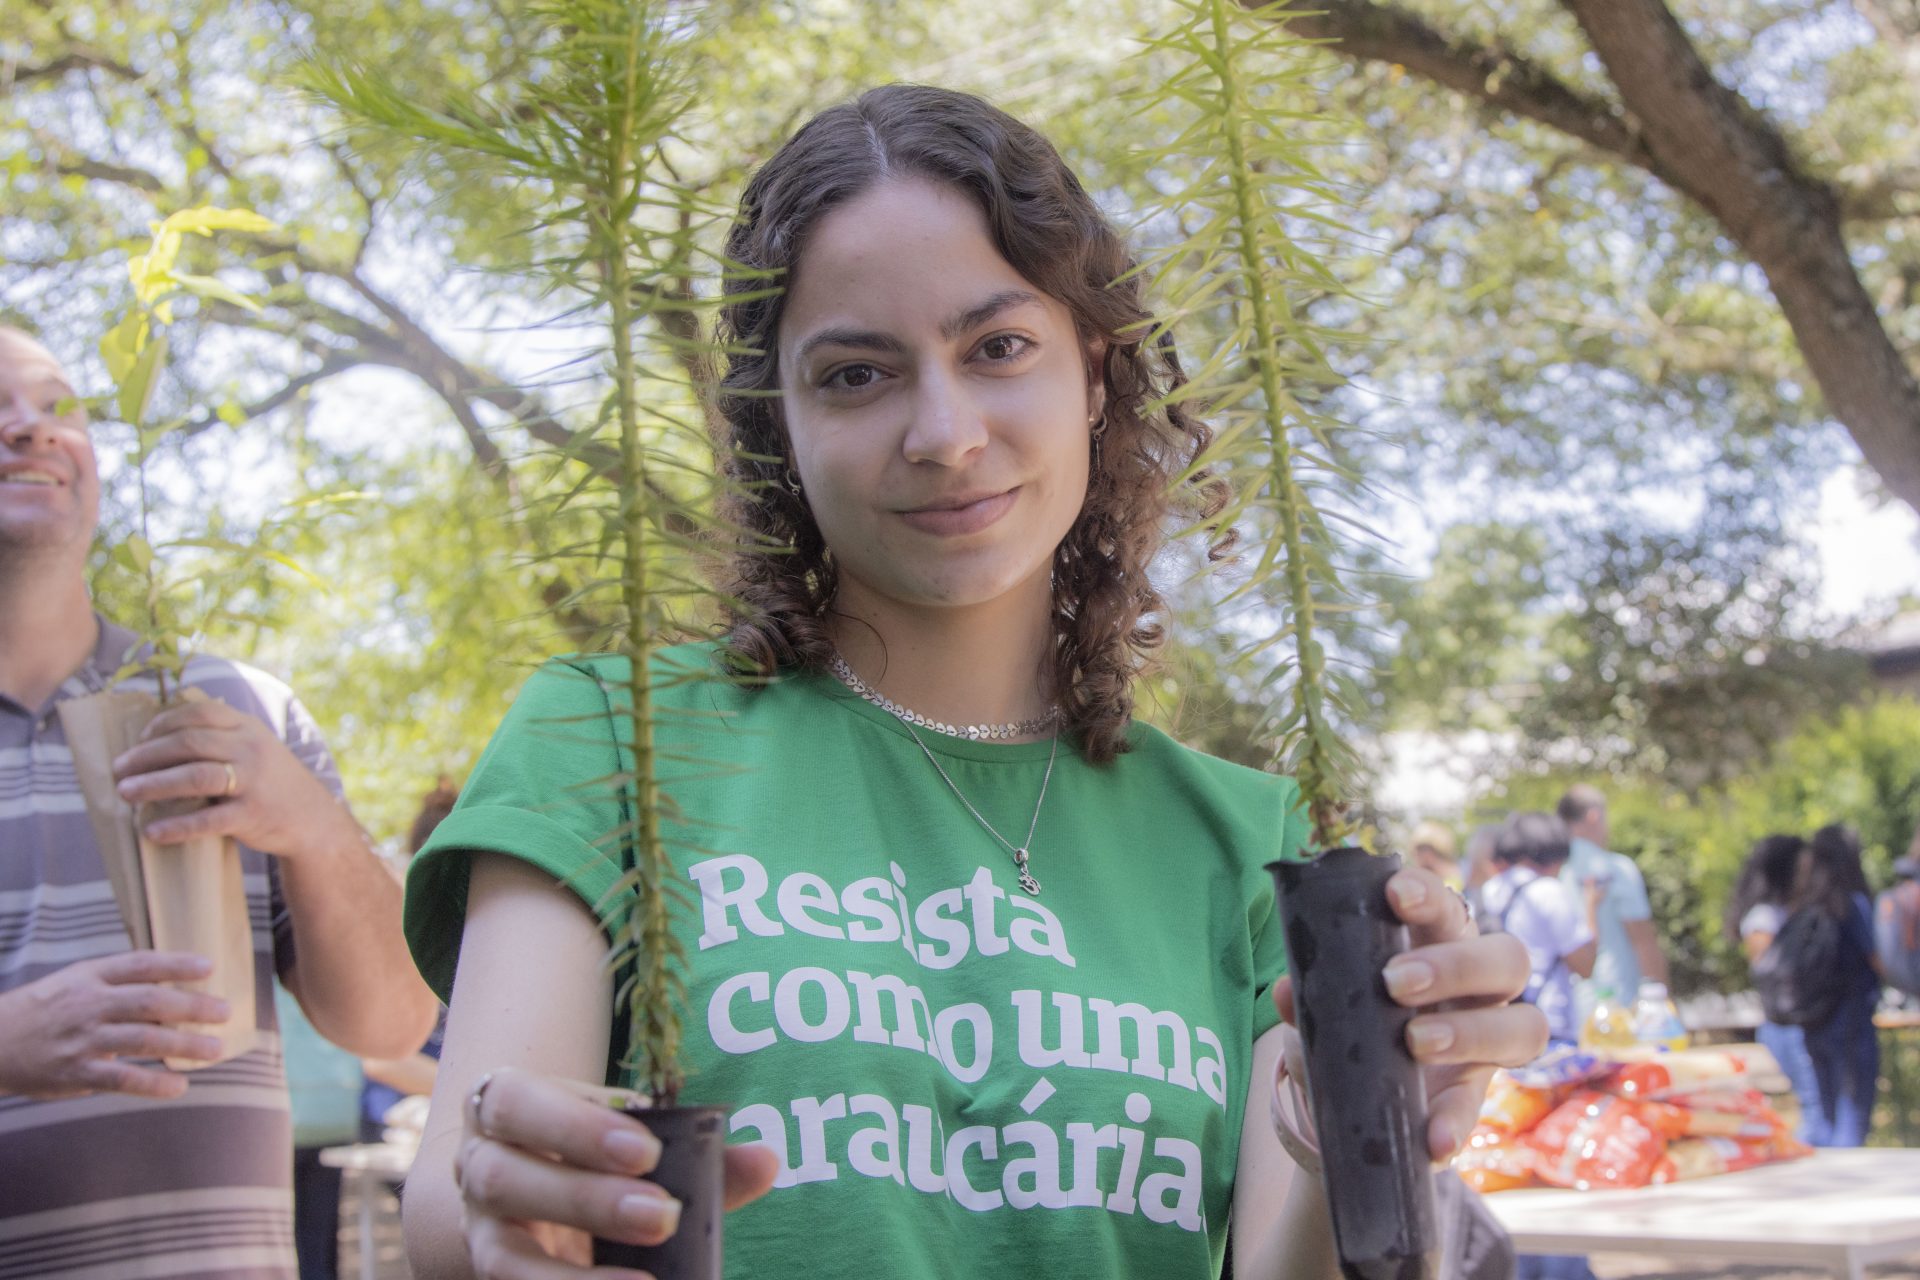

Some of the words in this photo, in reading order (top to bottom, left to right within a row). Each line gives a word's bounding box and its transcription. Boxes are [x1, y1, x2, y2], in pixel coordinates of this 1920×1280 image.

[688, 853, 1076, 969] Resista
[707, 966, 993, 1083] como
[1011, 989, 1227, 1111] uma
[729, 1076, 1206, 1233] araucária
